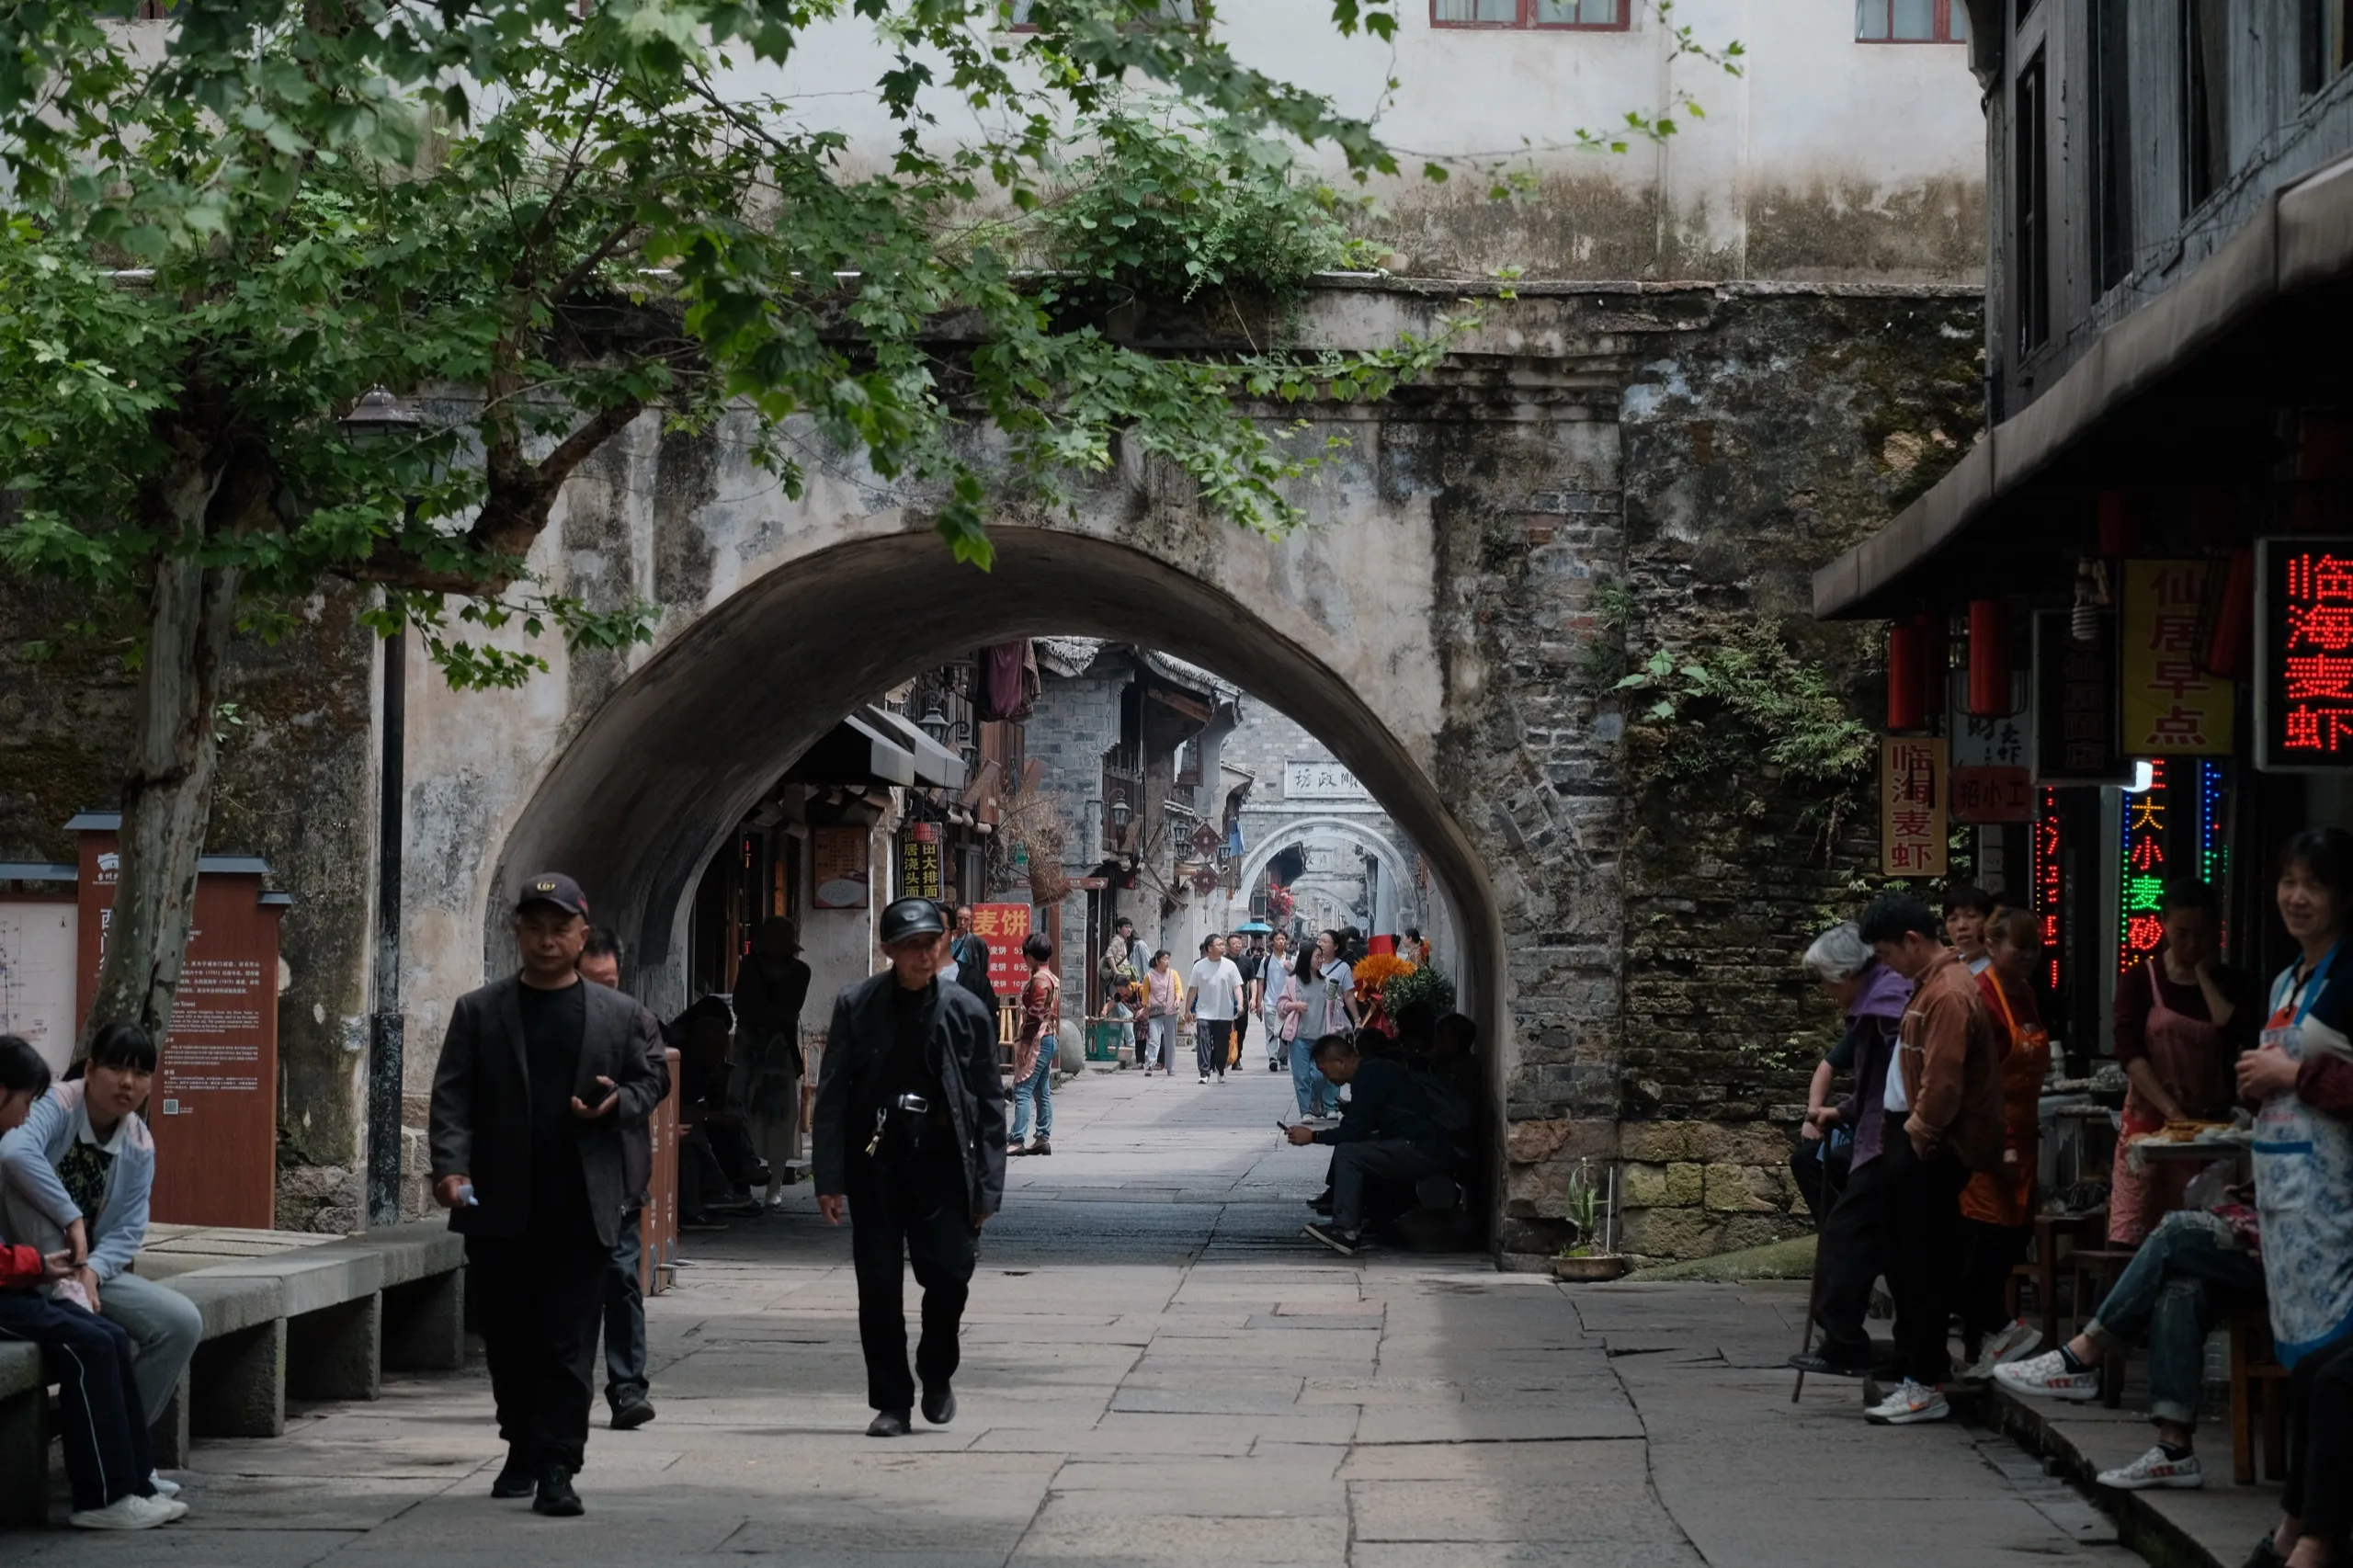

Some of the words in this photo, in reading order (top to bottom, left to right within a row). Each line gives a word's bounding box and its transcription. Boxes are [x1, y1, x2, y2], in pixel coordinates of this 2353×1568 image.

[2146, 568, 2210, 745] 仙居早点
[2284, 553, 2353, 752] 临海麦虾
[1892, 744, 1933, 870] 临海麦虾
[1961, 778, 2026, 809] 招小工
[922, 844, 938, 898] 田大排面
[973, 909, 1028, 937] 麦饼
[988, 946, 1006, 956] 麦饼
[991, 980, 1006, 988] 麦饼
